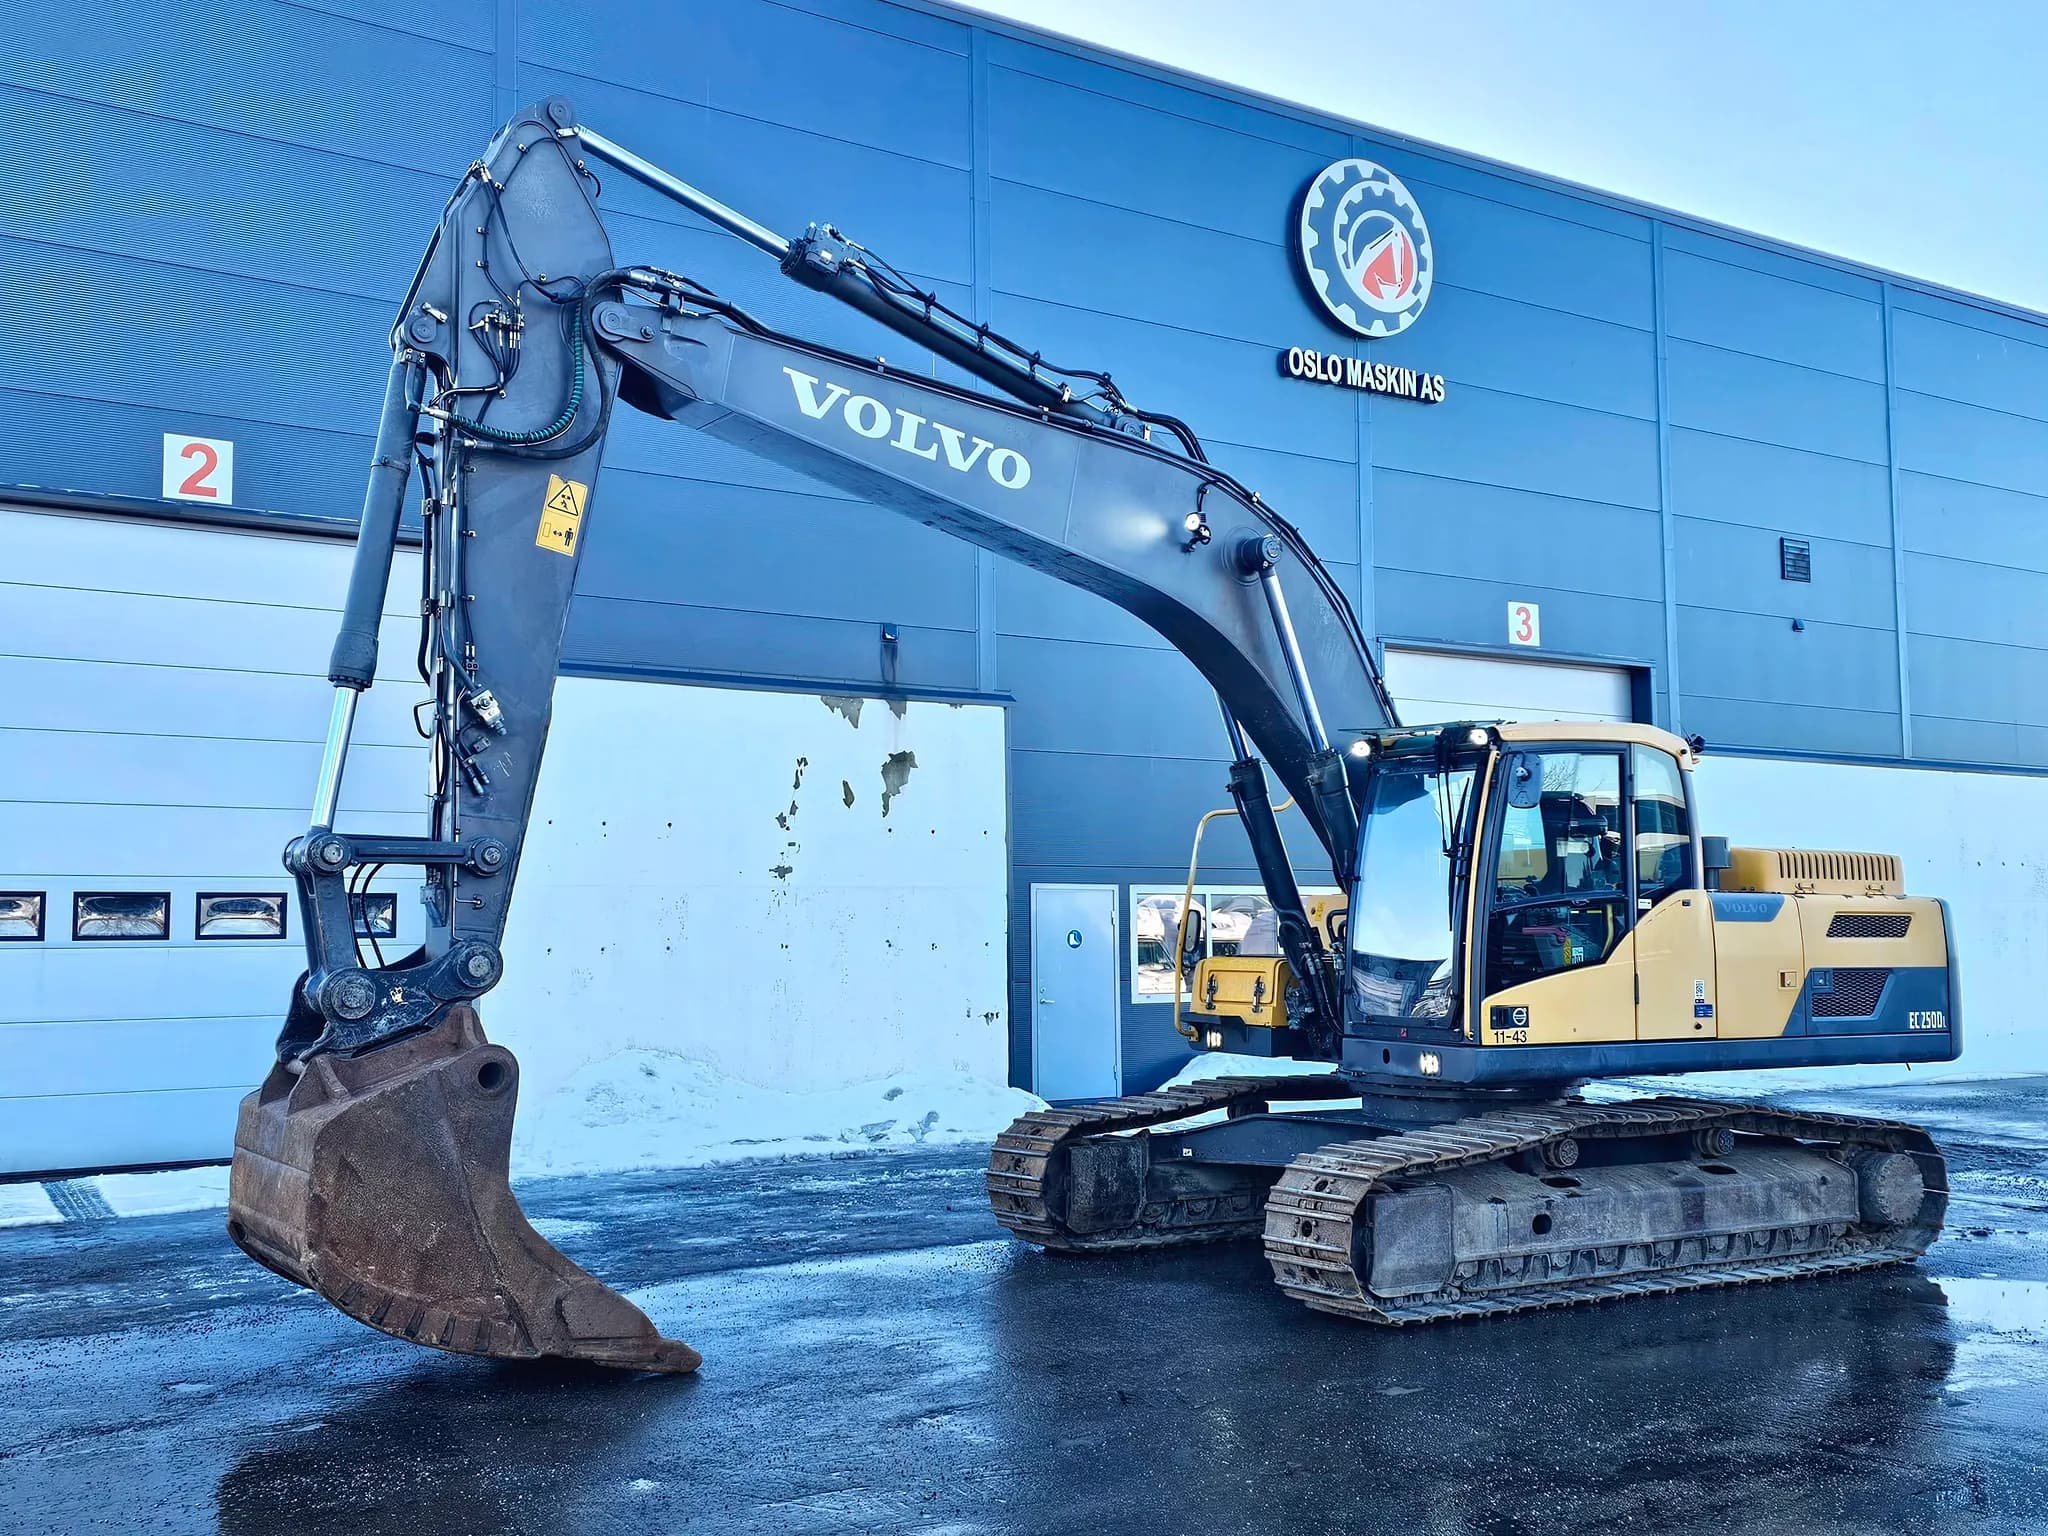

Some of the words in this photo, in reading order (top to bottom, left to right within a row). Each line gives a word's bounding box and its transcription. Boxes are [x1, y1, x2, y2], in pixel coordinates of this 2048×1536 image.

[1288, 346, 1342, 383] OSLO
[1346, 357, 1417, 397] MASKIN
[1420, 372, 1445, 402] AS
[783, 366, 1031, 489] VOLVO
[179, 442, 218, 498] 2
[1515, 606, 1533, 642] 3
[1721, 902, 1768, 913] VOLVO
[1494, 1030, 1527, 1044] 11-43
